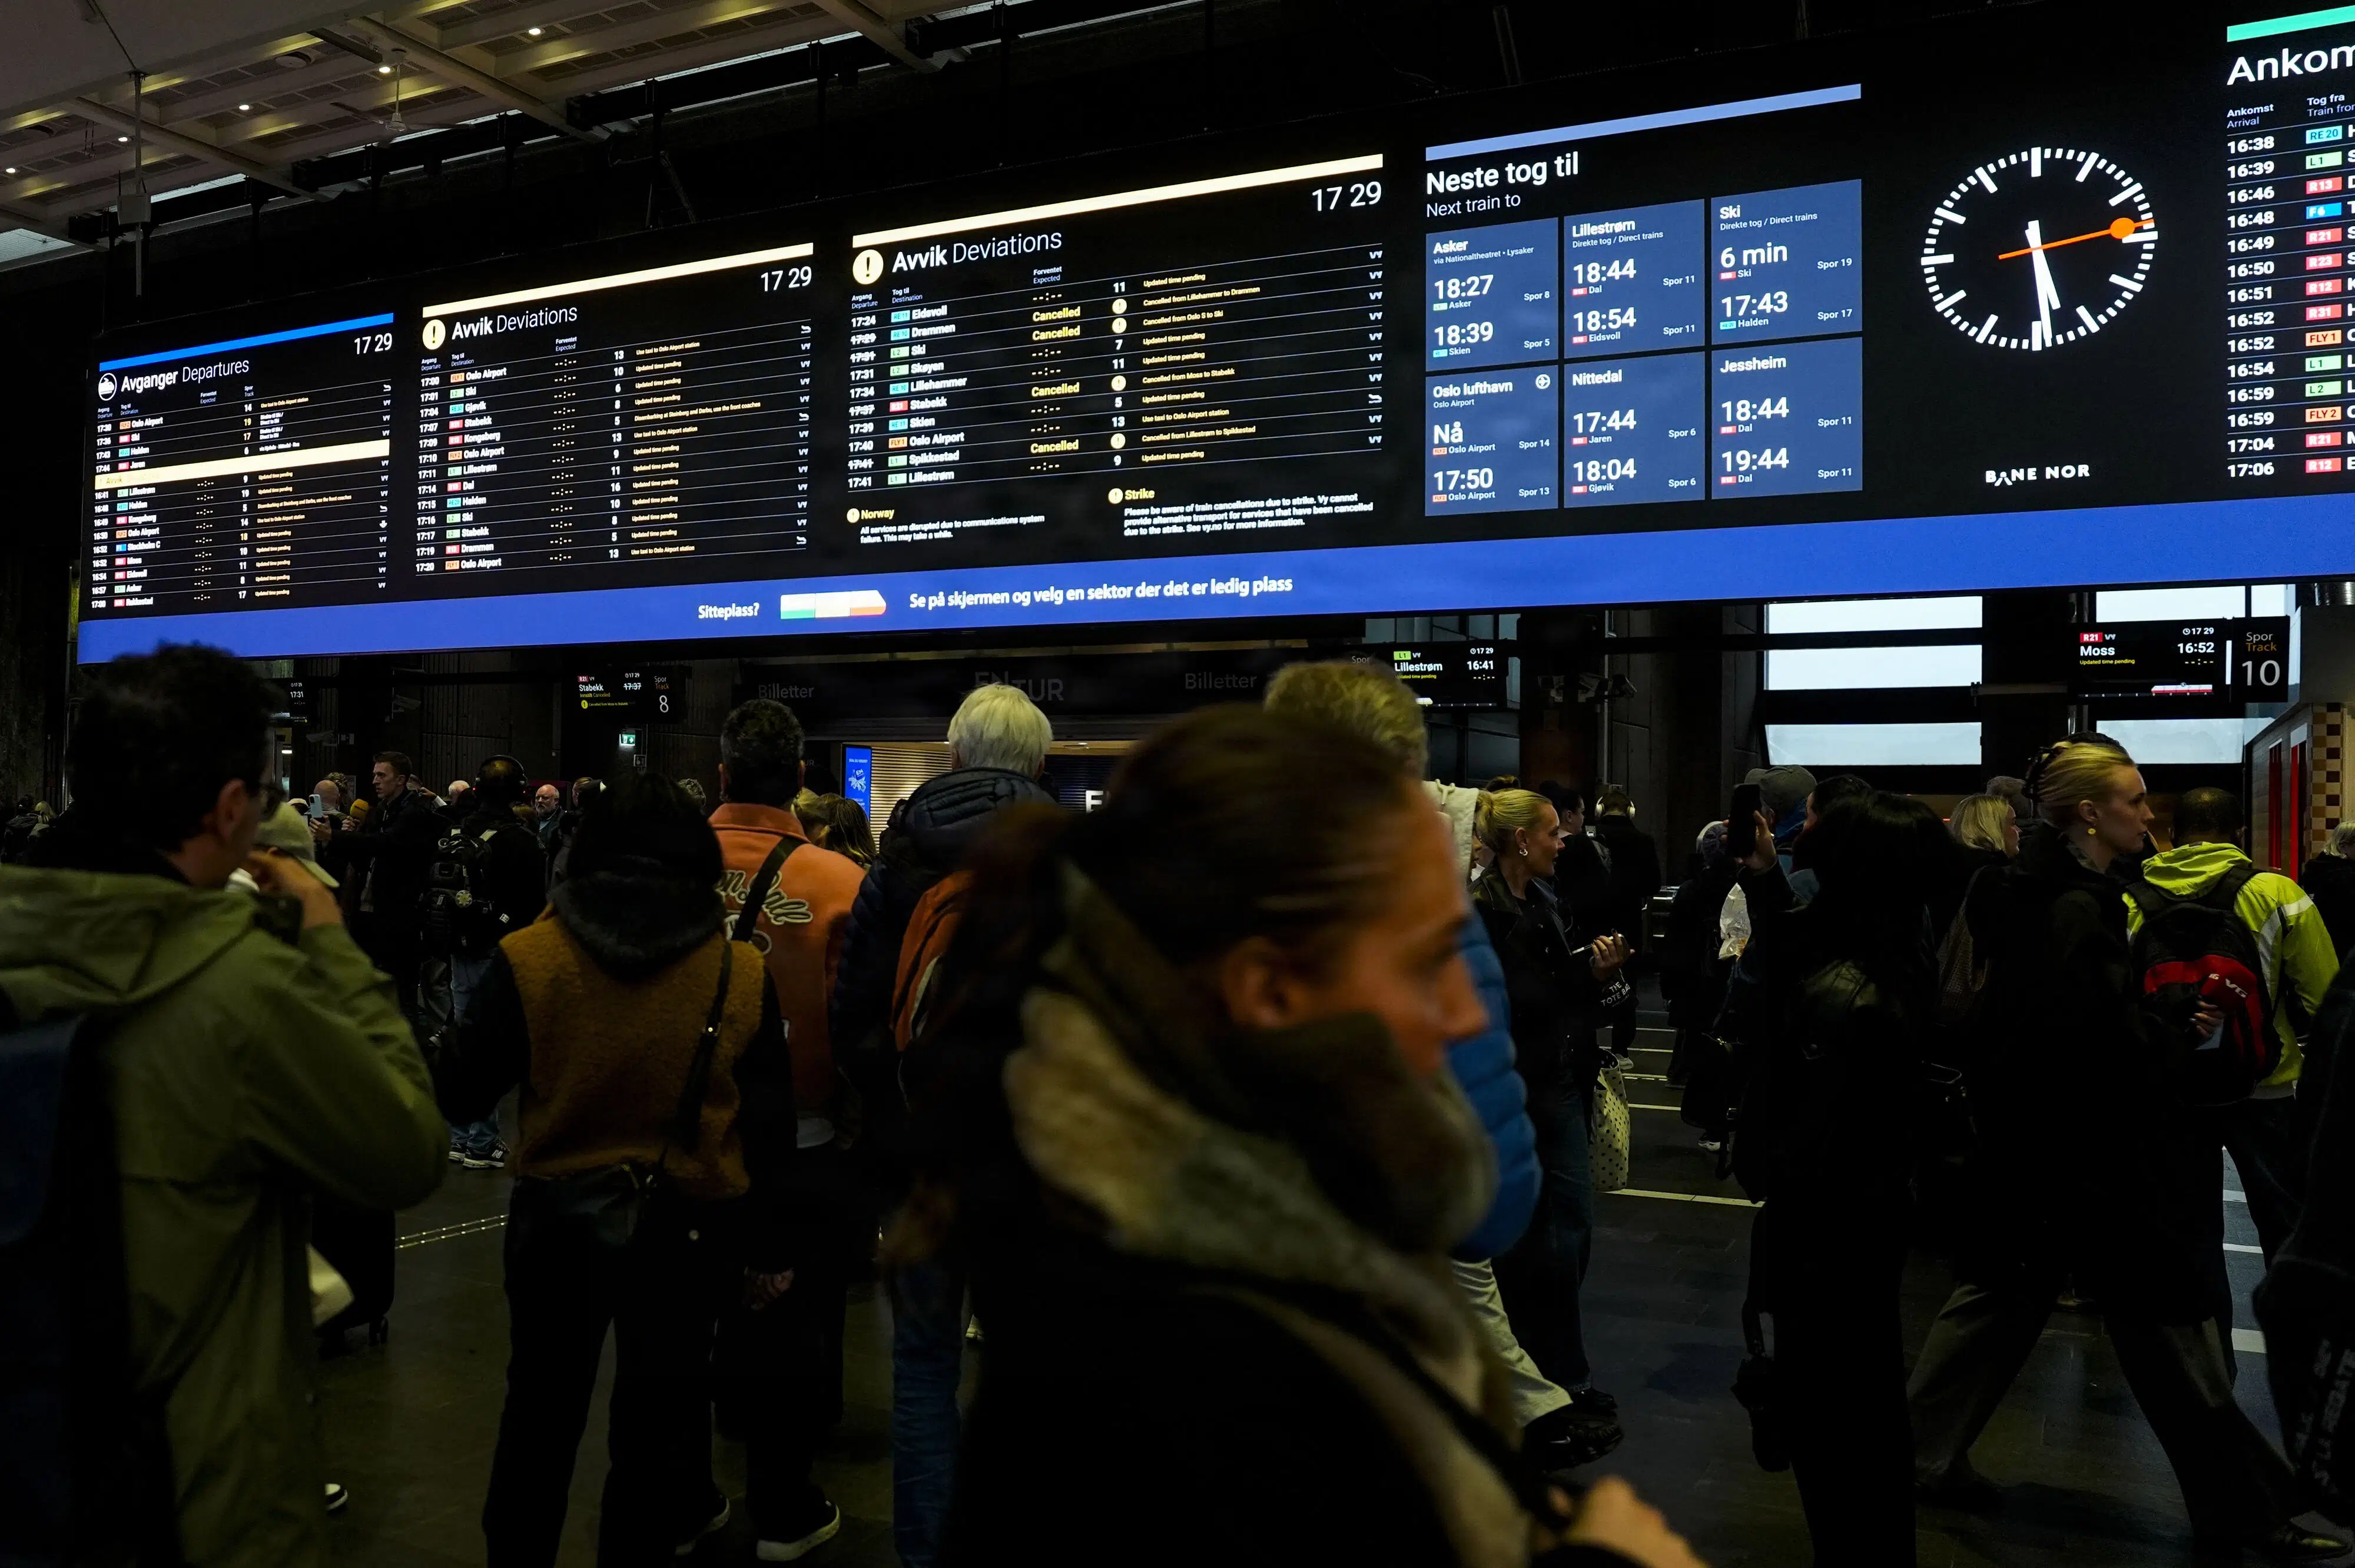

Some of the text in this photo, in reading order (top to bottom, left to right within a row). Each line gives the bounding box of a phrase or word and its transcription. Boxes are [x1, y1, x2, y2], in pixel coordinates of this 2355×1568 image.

[2307, 94, 2344, 105] Tog fra
[2227, 104, 2274, 118] Ankomst
[2307, 104, 2355, 117] Train fro
[2227, 117, 2259, 128] Arrival
[2228, 136, 2274, 154] 16:38
[1427, 151, 1578, 194] Neste tog til
[1312, 181, 1381, 211] 17 29
[1427, 194, 1520, 217] Next train to
[1720, 205, 1740, 219] Ski
[1720, 222, 1747, 230] Direkte
[1770, 215, 1793, 224] Direct
[1795, 213, 1817, 221] trains
[2228, 211, 2274, 228] 16:48
[1573, 221, 1636, 238] Lillestrøm
[892, 232, 1062, 273] Avvik Deviations
[1433, 240, 1468, 254] Asker
[2228, 236, 2274, 253] 16:49
[1445, 251, 1501, 263] Nationaltheatret
[1507, 247, 1534, 257] Lysaker
[1721, 242, 1787, 268] 6 min
[1574, 258, 1636, 284] 18:44
[1817, 258, 1852, 270] Spor 19
[761, 266, 811, 291] 17 29
[1182, 274, 1206, 283] pending
[1738, 269, 1751, 277] Ski
[1435, 275, 1493, 299] 18:27
[1589, 285, 1601, 294] Dal
[1663, 278, 1683, 287] Spor
[2228, 286, 2271, 303] 16:51
[1449, 300, 1471, 308] Asker
[1722, 291, 1787, 317] 17:43
[452, 307, 577, 340] Avvik Deviations
[851, 315, 876, 327] 17:24
[1574, 307, 1636, 333] 18:54
[1738, 318, 1769, 327] Halden
[912, 324, 956, 338] Drammen
[1032, 325, 1080, 341] Cancelled
[1434, 322, 1493, 346] 18:39
[1589, 331, 1620, 342] Eidsvoll
[2310, 334, 2328, 343] FLY
[354, 333, 392, 354] 17 29
[911, 363, 944, 375] Skøyen
[1720, 356, 1786, 373] Jessheim
[121, 360, 249, 393] Avganger Departures
[1573, 369, 1622, 386] Nittedal
[850, 386, 874, 398] 17:34
[911, 378, 967, 392] Lillehammer
[1433, 381, 1512, 398] Oslo lufthavn
[465, 401, 486, 413] Gjøvik
[1722, 397, 1789, 421] 18:44
[1574, 409, 1636, 433] 17:44
[910, 432, 964, 446] Oslo Airport
[1434, 421, 1463, 444] Nå
[1031, 439, 1079, 453] Cancelled
[1519, 441, 1537, 450] Spor
[2228, 437, 2274, 452] 17:04
[419, 454, 437, 463] 17:10
[1573, 459, 1637, 484] 18:04
[1986, 464, 2089, 486] BANE NOR
[2228, 462, 2274, 477] 17:06
[1434, 468, 1492, 491] 17:50
[1125, 488, 1155, 500] Strike
[1589, 483, 1614, 493] Gjøvik
[861, 510, 894, 519] Norway
[462, 544, 494, 553] Drammen
[910, 576, 1293, 610] Se på skjermen og velg en sektor der det er ledig plass
[698, 603, 759, 620] Sitteplass?
[2247, 632, 2273, 643] Spor
[2081, 646, 2115, 656] Moss
[2178, 642, 2214, 653] 16:52
[2245, 642, 2277, 652] Track
[1395, 662, 1442, 672] Lillestrøm
[1467, 660, 1493, 670] 16:41
[2242, 660, 2280, 686] 10
[1185, 672, 1257, 689] Billetter
[759, 683, 814, 699] Billetter
[659, 695, 668, 713] 8
[2225, 978, 2248, 998] VG
